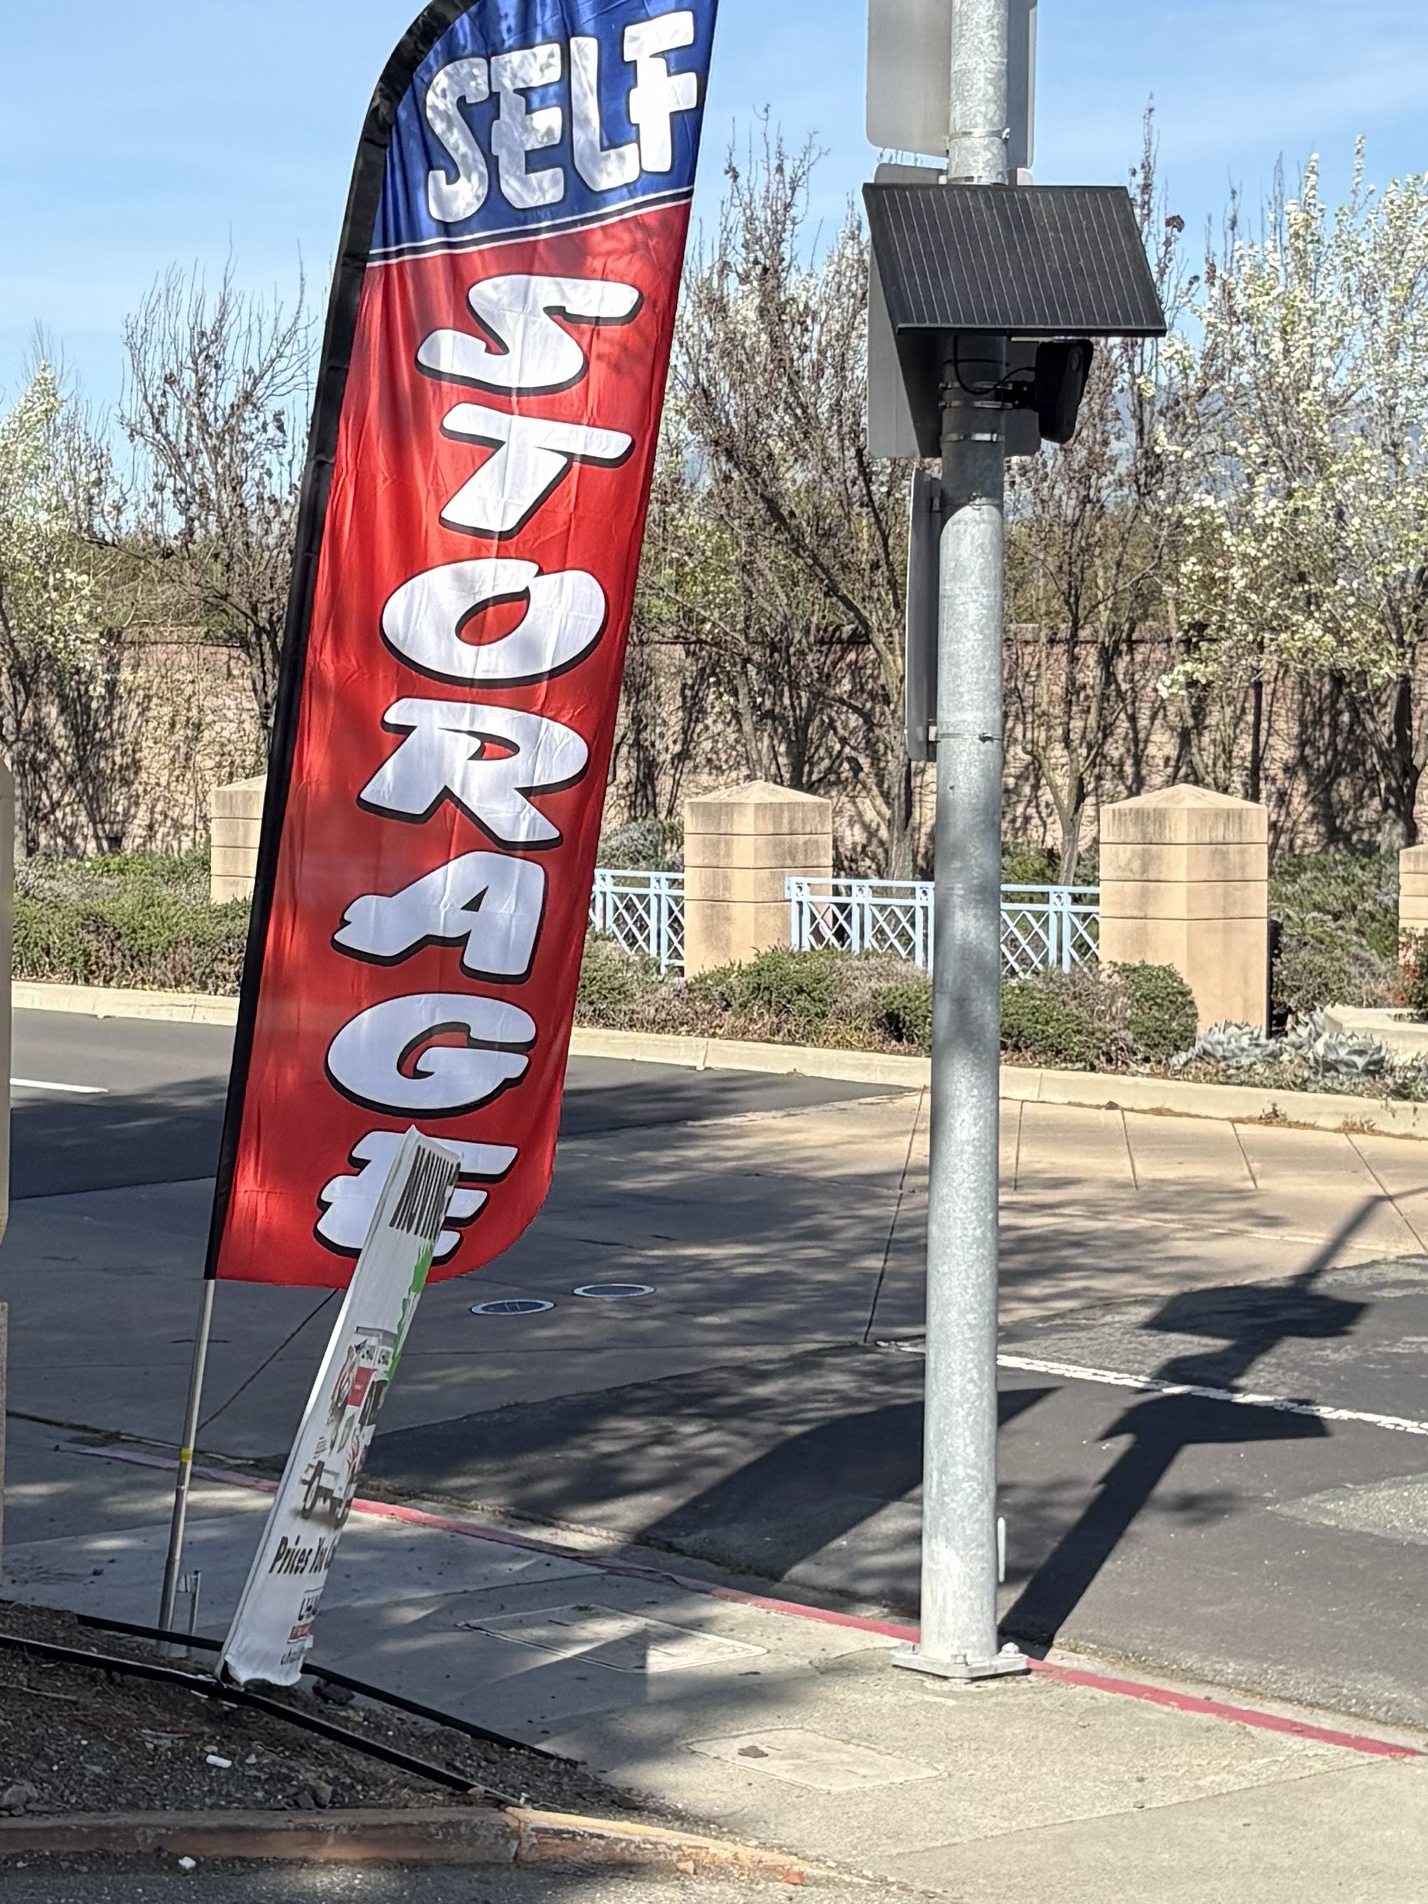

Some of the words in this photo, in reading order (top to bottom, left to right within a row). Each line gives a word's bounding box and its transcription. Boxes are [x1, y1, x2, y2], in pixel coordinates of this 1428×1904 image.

[426, 10, 698, 223] SELF
[314, 273, 642, 1264] STORAGE
[268, 1533, 314, 1575] Prices
